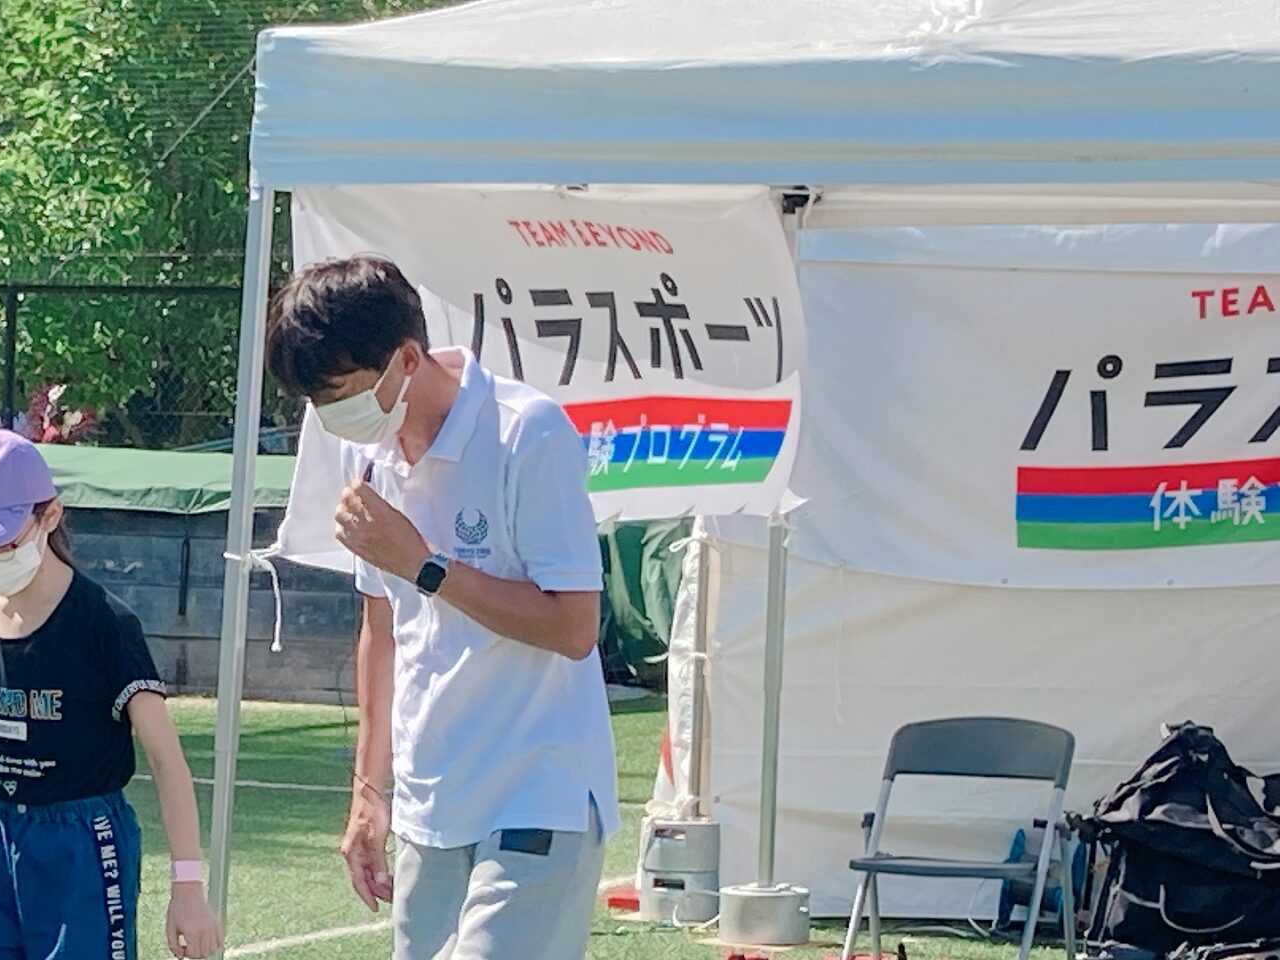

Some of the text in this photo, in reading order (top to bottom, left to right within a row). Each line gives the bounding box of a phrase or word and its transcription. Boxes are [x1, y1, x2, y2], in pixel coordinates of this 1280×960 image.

[507, 219, 573, 247] TEAM
[471, 272, 783, 386] パラスポーツ
[1149, 475, 1280, 532] 体験
[100, 845, 119, 879] ME?
[106, 884, 124, 925] WILL
[111, 929, 126, 960] YOU
